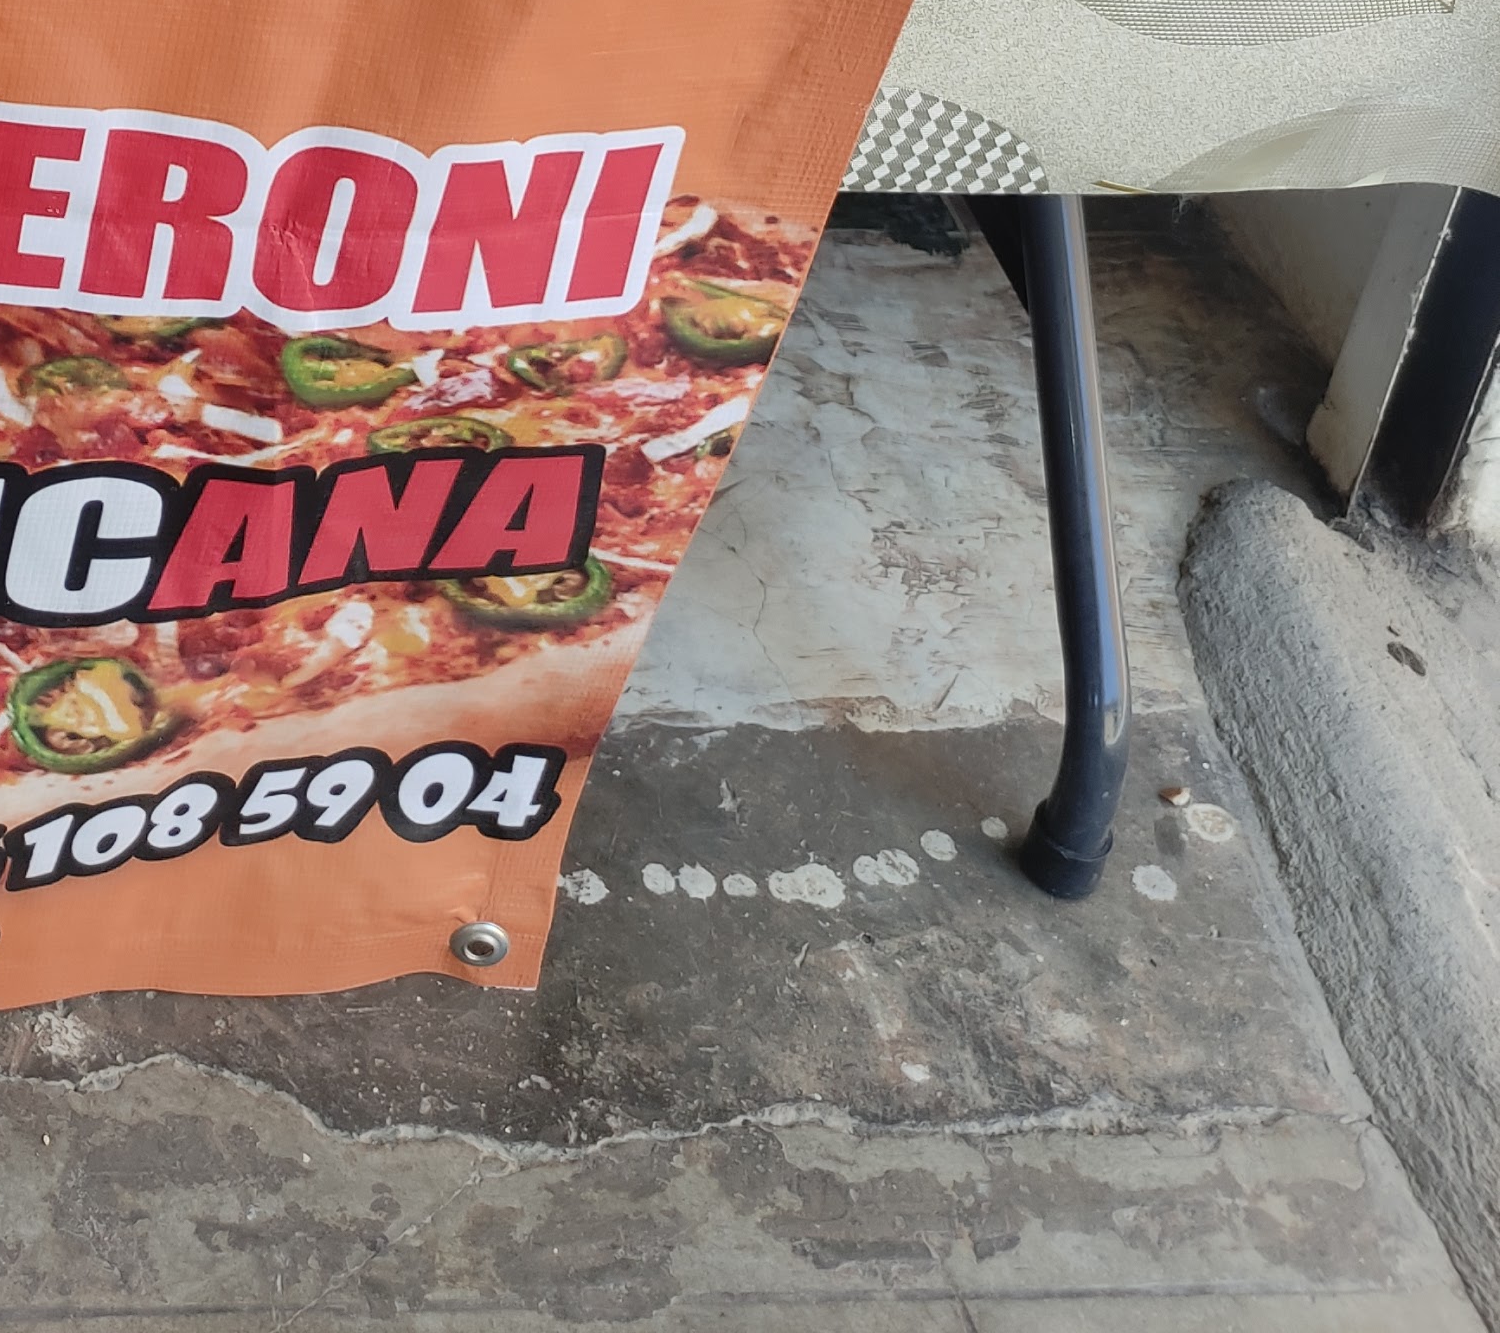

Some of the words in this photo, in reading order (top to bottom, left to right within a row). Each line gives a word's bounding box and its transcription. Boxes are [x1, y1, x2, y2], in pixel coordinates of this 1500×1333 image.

[22, 780, 218, 879] 108
[238, 756, 377, 834] 59
[396, 753, 560, 831] 04
